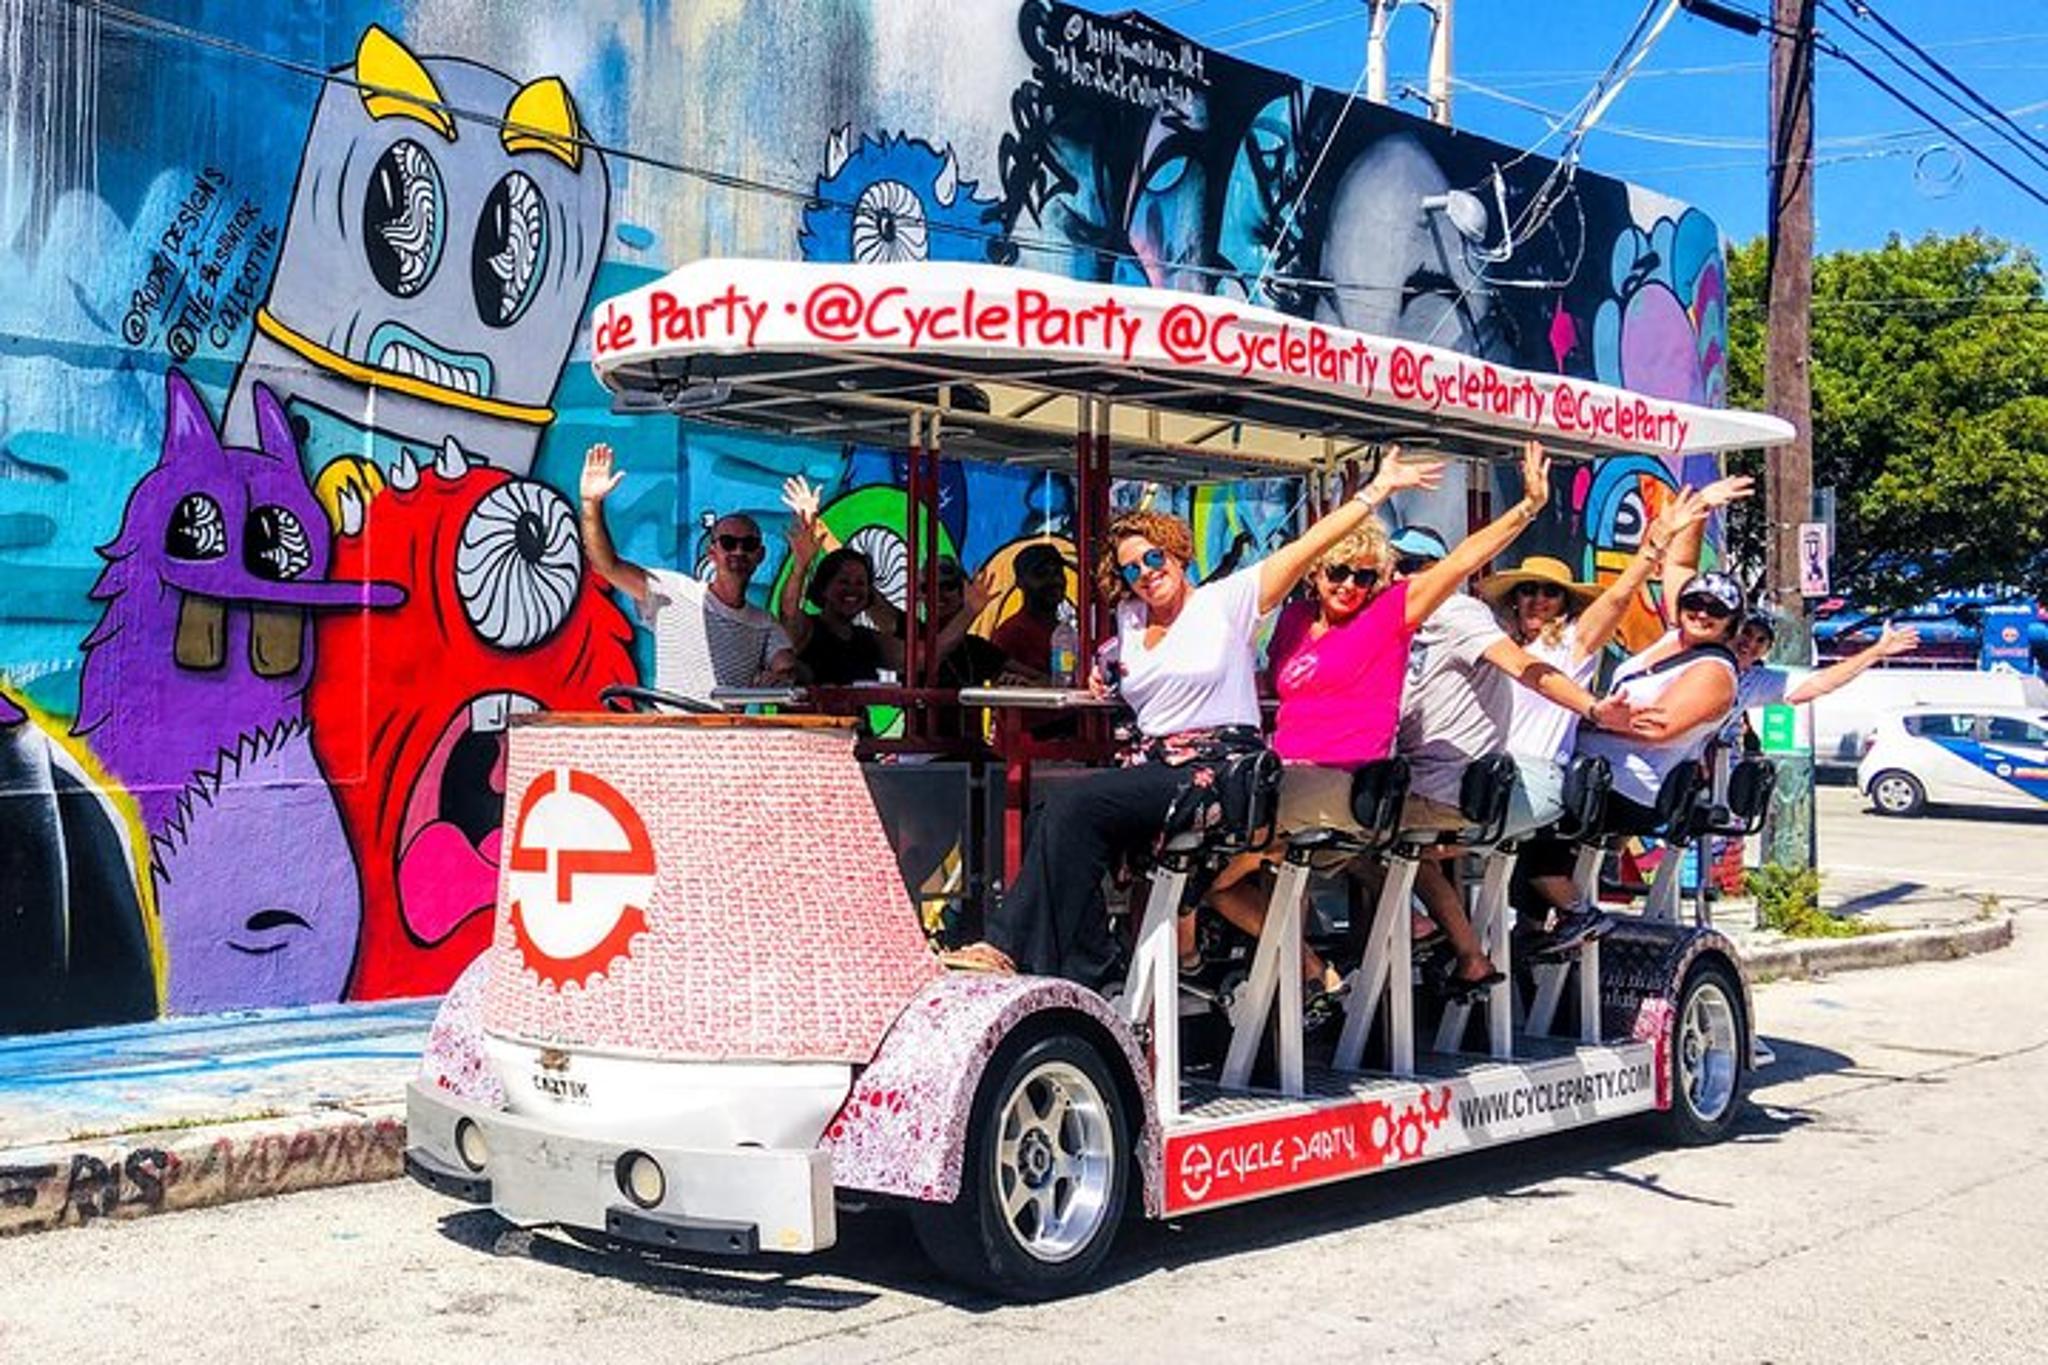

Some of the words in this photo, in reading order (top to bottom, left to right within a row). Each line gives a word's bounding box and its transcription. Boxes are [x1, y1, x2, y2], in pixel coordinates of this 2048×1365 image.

[650, 285, 768, 347] Party
[803, 282, 1141, 361] @CycleParty
[1158, 303, 1379, 397] @CycleParty
[1389, 346, 1546, 429] @CycleParty
[1552, 382, 1688, 452] @CycleParty
[1459, 1063, 1651, 1129] WWW.CYCLEPARTY.COM
[1216, 1139, 1286, 1183] CYCLE
[1290, 1124, 1358, 1173] PARTY
